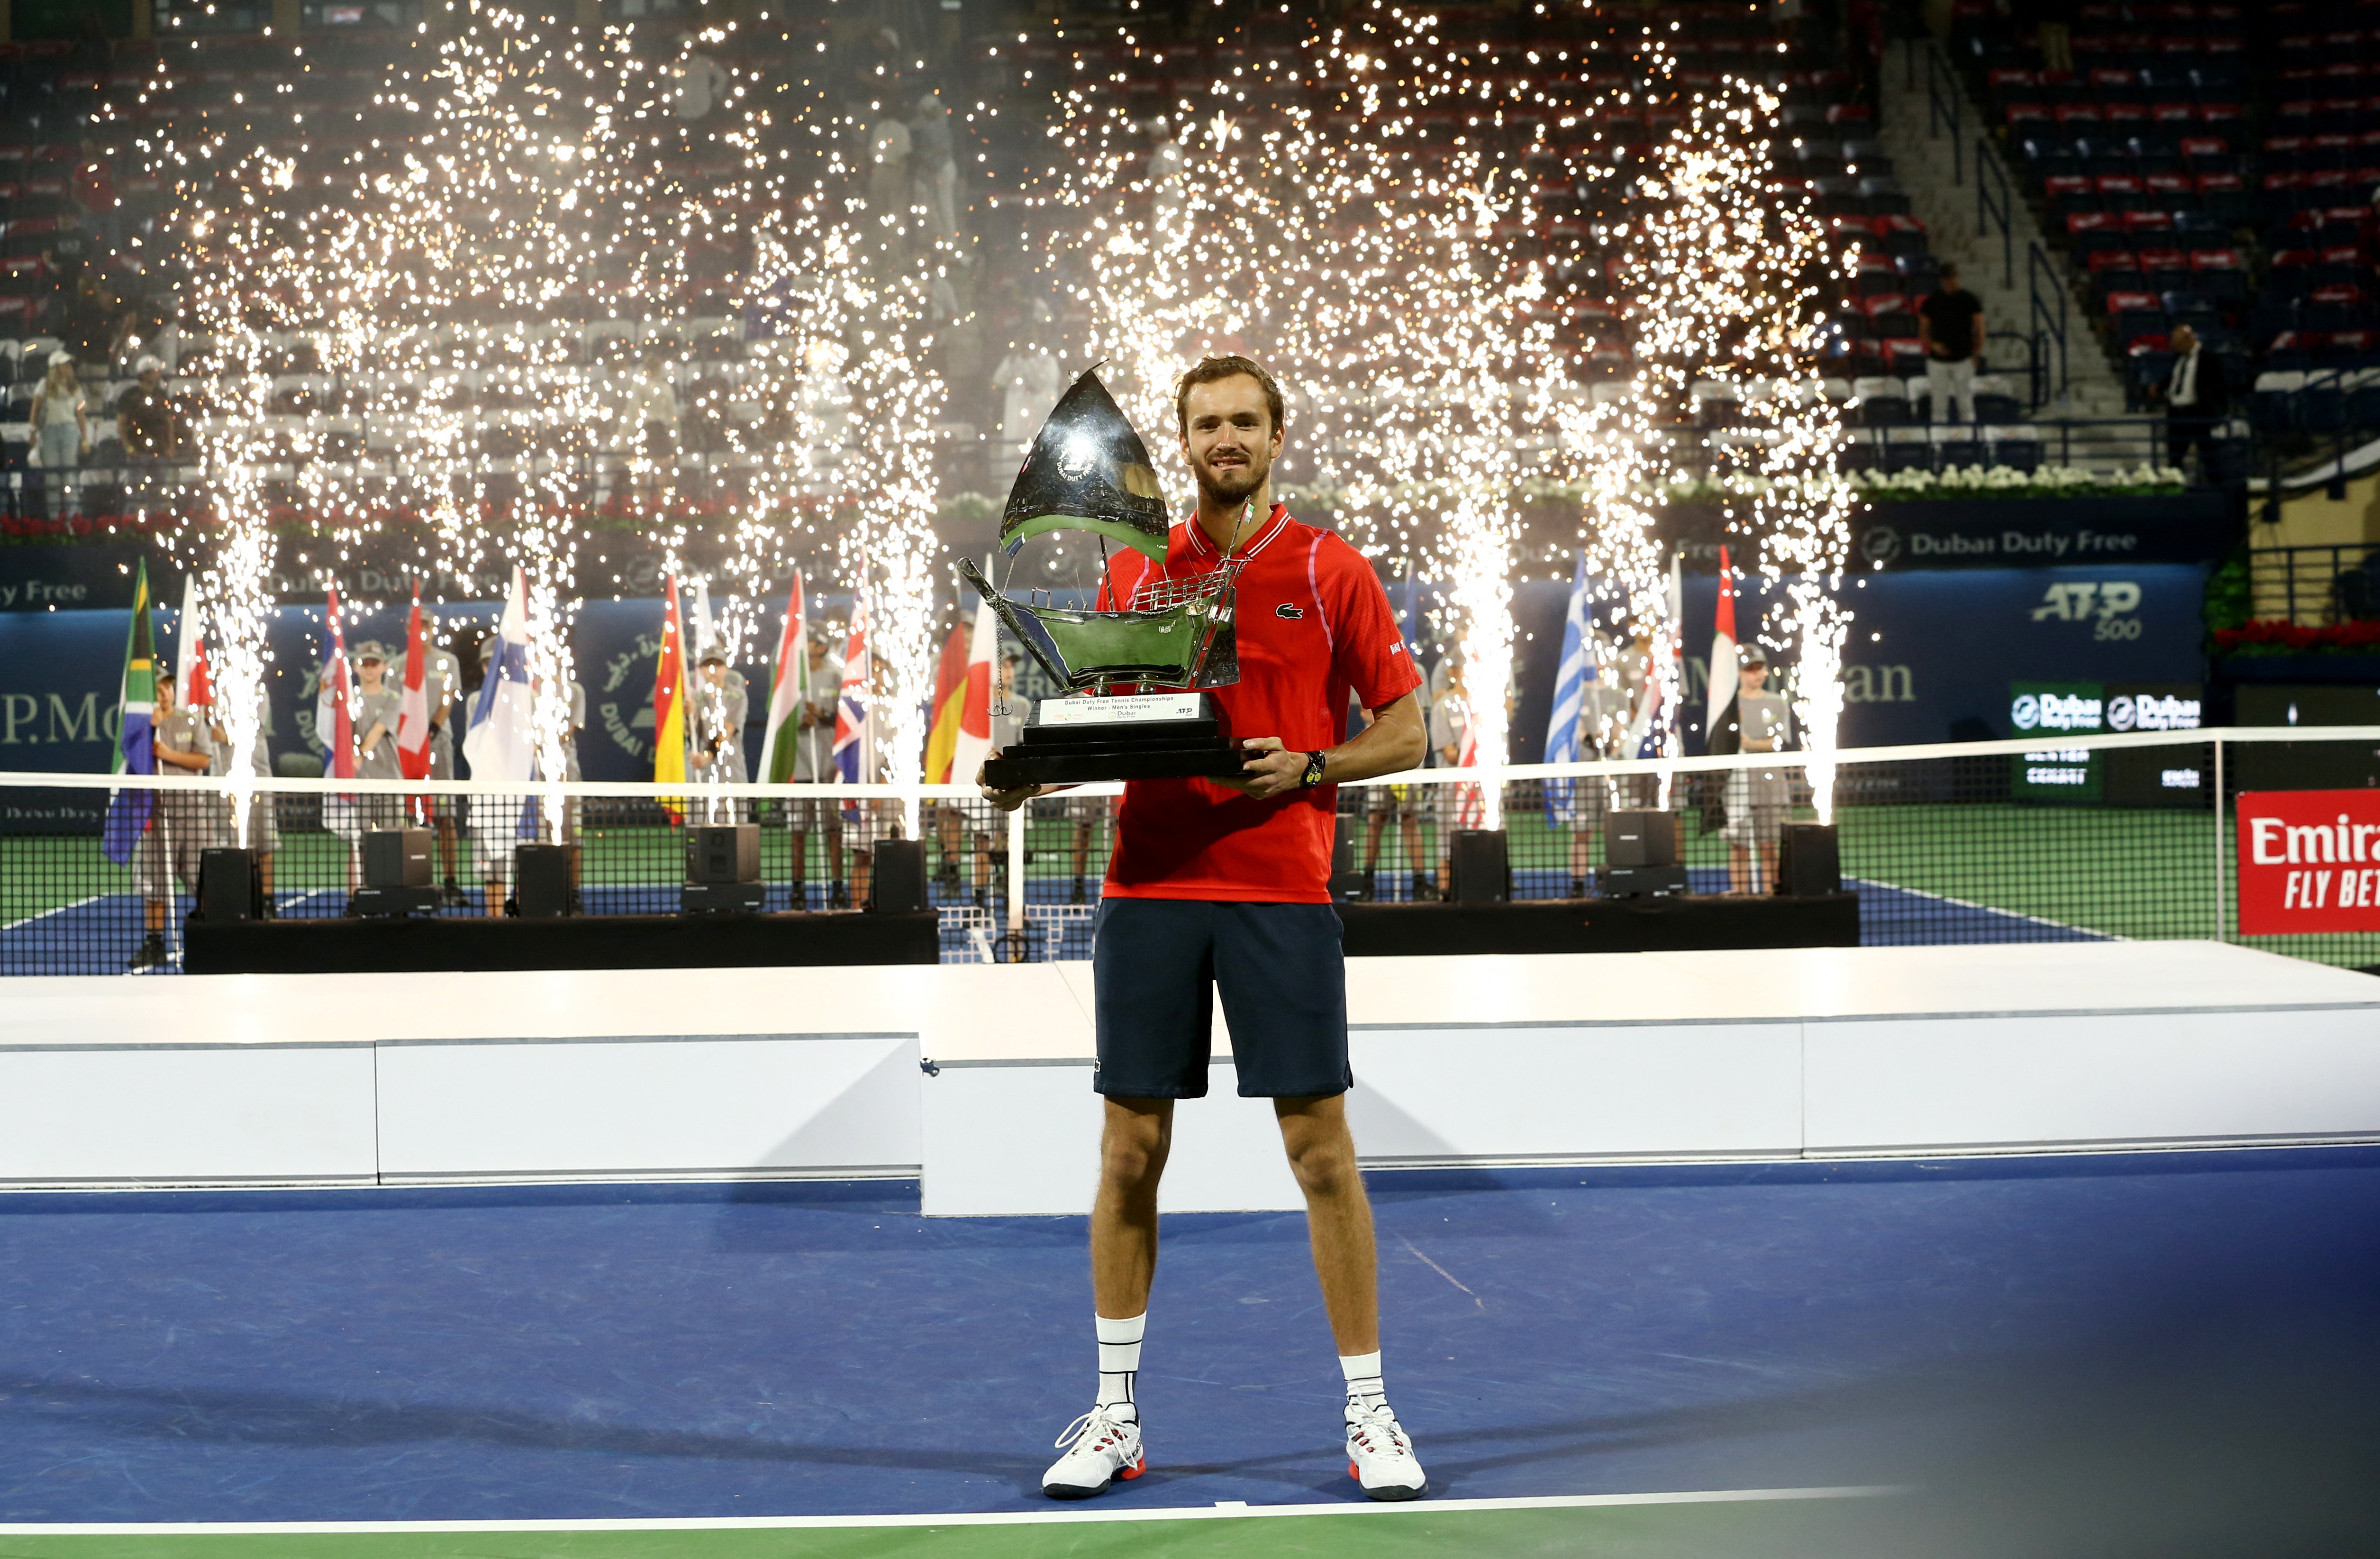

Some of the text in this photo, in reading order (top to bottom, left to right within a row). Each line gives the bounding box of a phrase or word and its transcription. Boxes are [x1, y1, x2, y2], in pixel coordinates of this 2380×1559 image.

[1057, 462, 1067, 479] DUBAI
[1067, 473, 1082, 482] DUTY
[1911, 529, 2137, 557] Dubai Duty Free
[26, 579, 87, 602] Free
[268, 570, 352, 593] Dubi
[2031, 581, 2141, 620] ATP
[2093, 619, 2141, 641] 500
[599, 702, 644, 757] DUBAI
[2284, 870, 2332, 910] FLY
